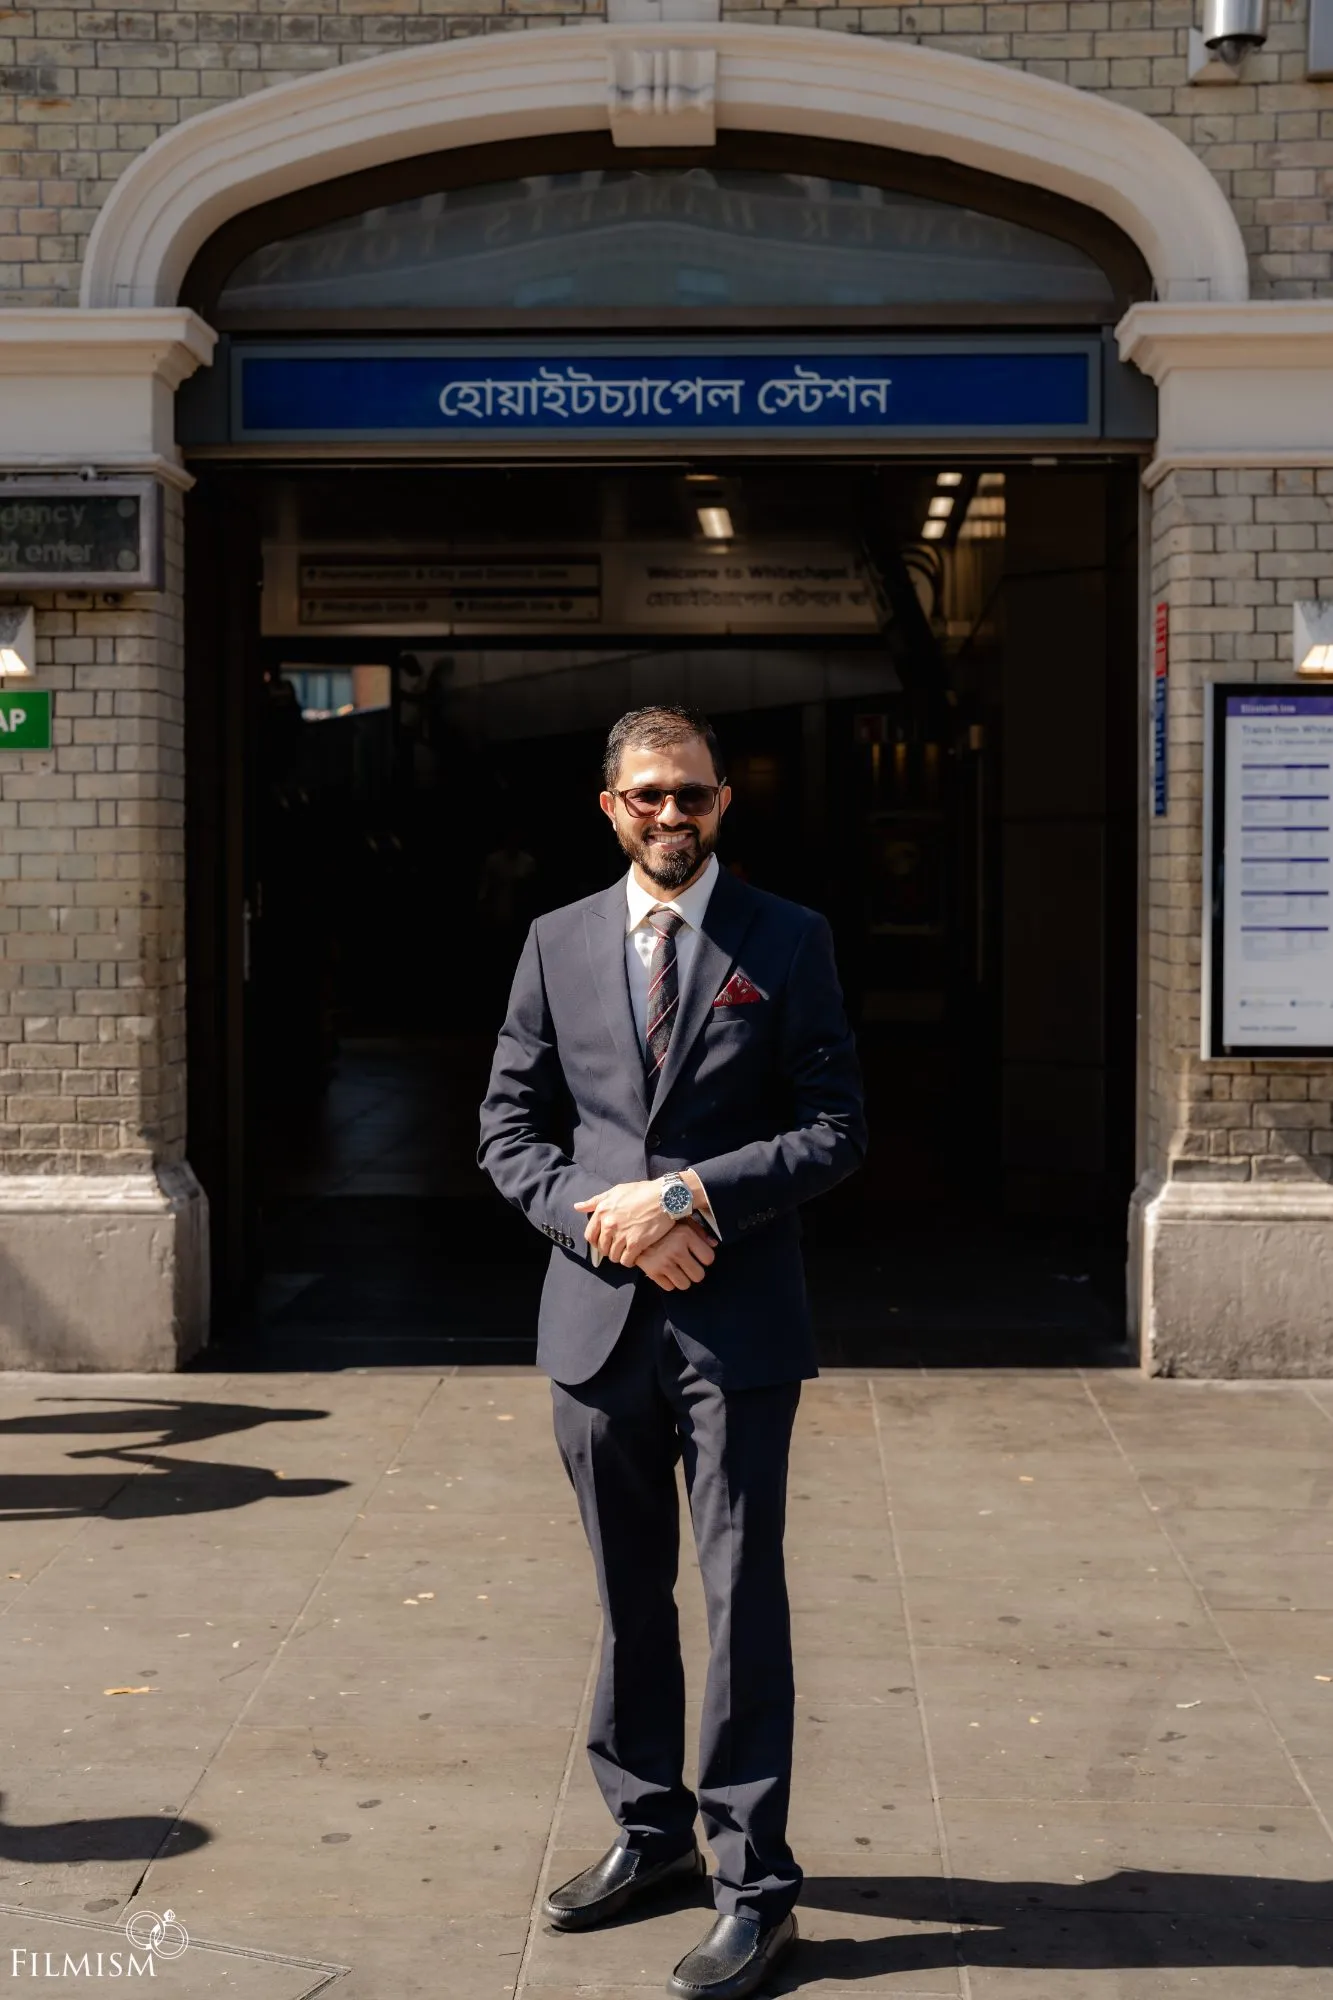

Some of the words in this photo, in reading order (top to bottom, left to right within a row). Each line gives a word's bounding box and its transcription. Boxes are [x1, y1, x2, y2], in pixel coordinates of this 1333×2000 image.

[440, 366, 745, 418] হোয়াইটচ্যাপেল
[757, 365, 891, 415] স্টেশন
[25, 539, 94, 563] enter
